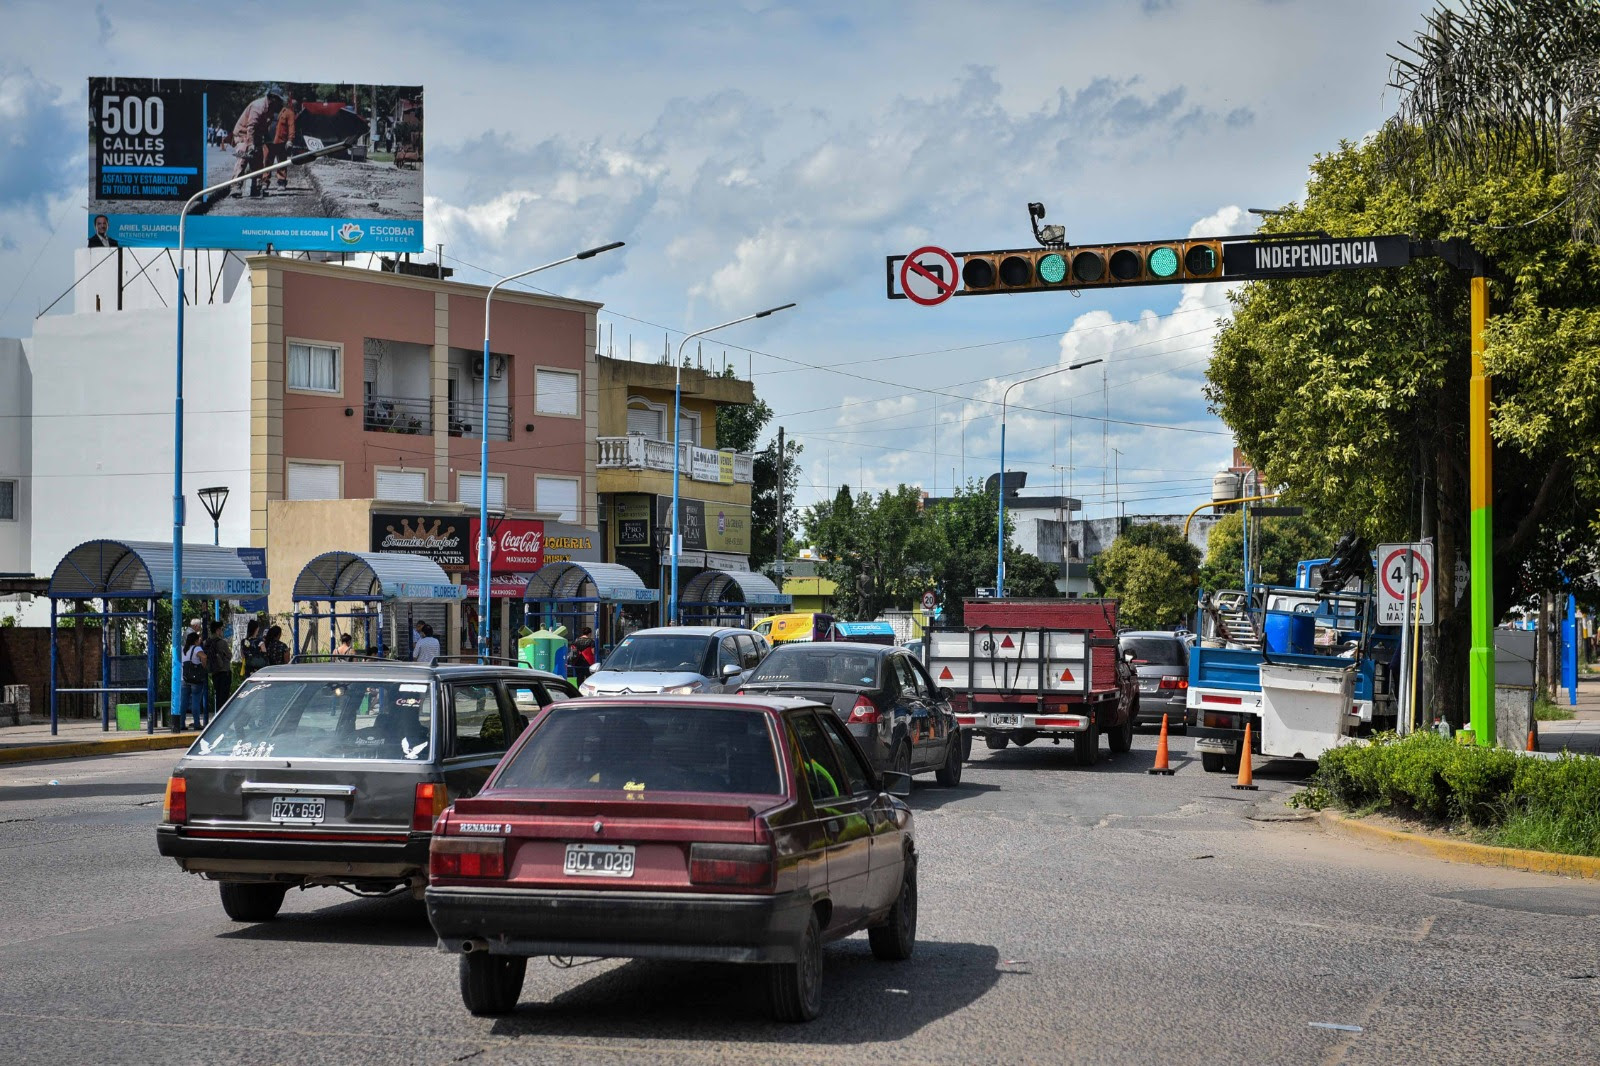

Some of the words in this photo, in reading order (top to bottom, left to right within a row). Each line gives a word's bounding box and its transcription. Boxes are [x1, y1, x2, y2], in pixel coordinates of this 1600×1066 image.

[102, 95, 164, 135] 500
[103, 137, 165, 151] CALLES
[103, 153, 165, 167] NUEVAS
[102, 174, 133, 184] ASFALTO
[134, 174, 139, 184] Y
[140, 174, 188, 185] ESTABILIZADO
[102, 185, 111, 195] EN
[114, 185, 131, 195] TODO
[132, 185, 140, 195] EL
[119, 224, 140, 232] ARIEL
[142, 224, 185, 232] SUJARCHU
[369, 226, 415, 237] ESCOBAR
[1255, 241, 1378, 269] INDEPENDENCIA
[381, 534, 424, 547] Sommier
[425, 534, 460, 550] Confort
[501, 530, 542, 553] Coca-Cola
[506, 556, 537, 564] MAXIKIOSCO
[1391, 566, 1402, 583] 4
[190, 579, 226, 593] ESCOBAR
[227, 580, 259, 593] FLORECE
[433, 586, 457, 598] FLORECE
[925, 595, 934, 605] 20
[1388, 603, 1423, 611] ALTRA
[273, 803, 295, 817] RZX
[301, 804, 323, 818] 693
[567, 851, 595, 870] BCI
[604, 852, 632, 871] 028
